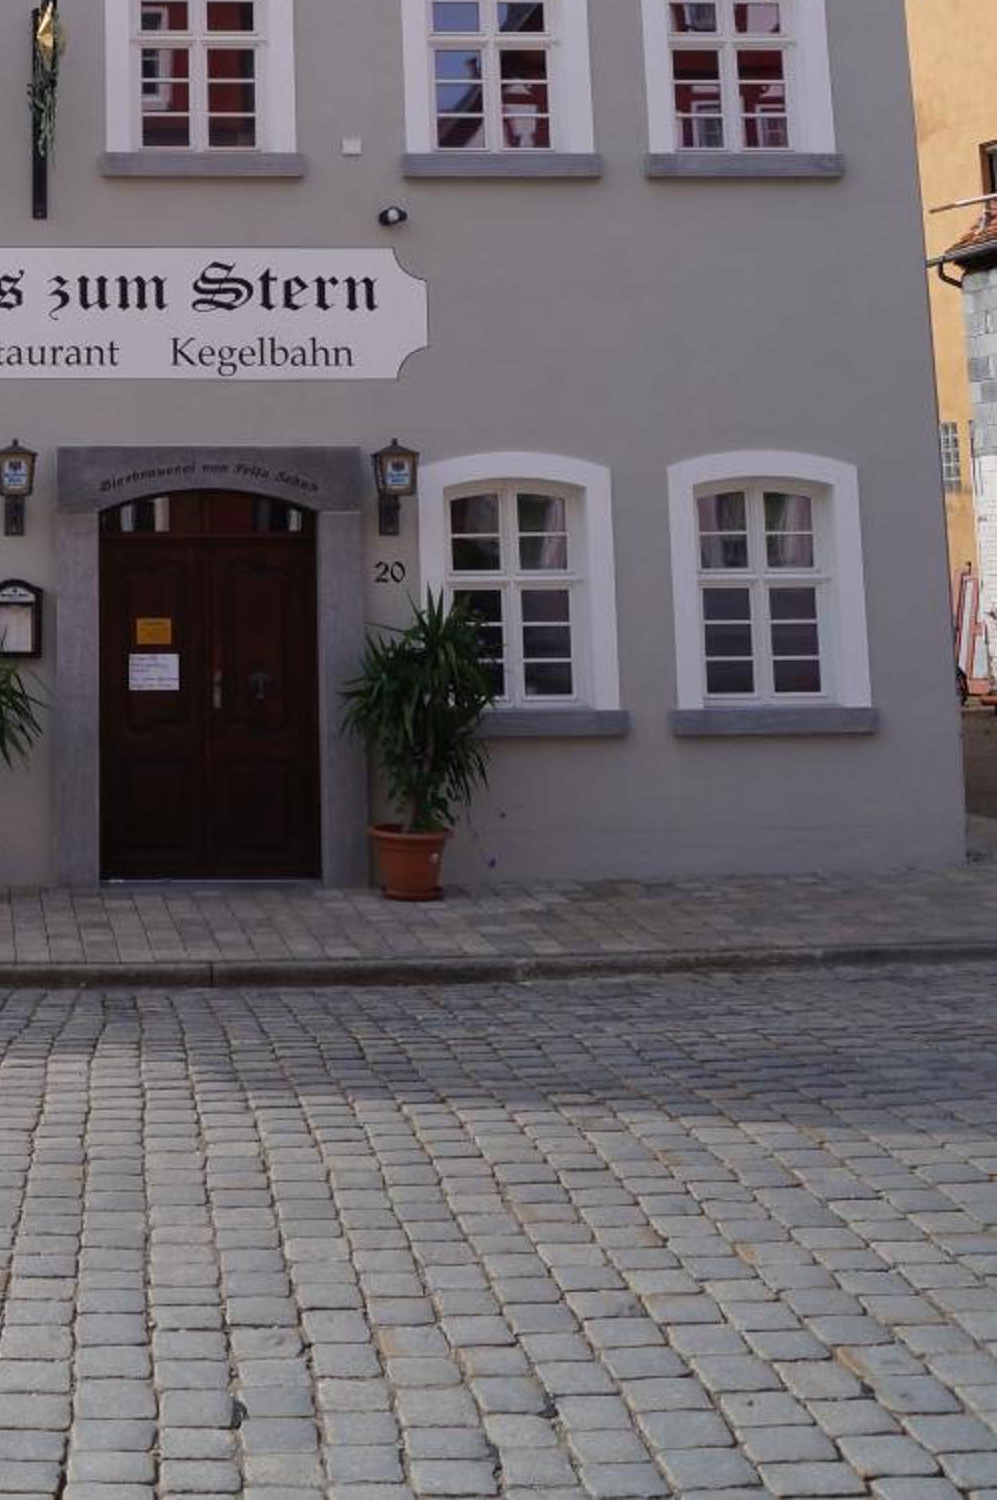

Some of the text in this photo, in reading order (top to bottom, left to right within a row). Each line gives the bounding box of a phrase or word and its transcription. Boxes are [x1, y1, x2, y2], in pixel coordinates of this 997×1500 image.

[50, 275, 168, 321] zum
[192, 261, 378, 313] Stern
[171, 336, 354, 377] Kegelbahn
[374, 561, 406, 583] 20
